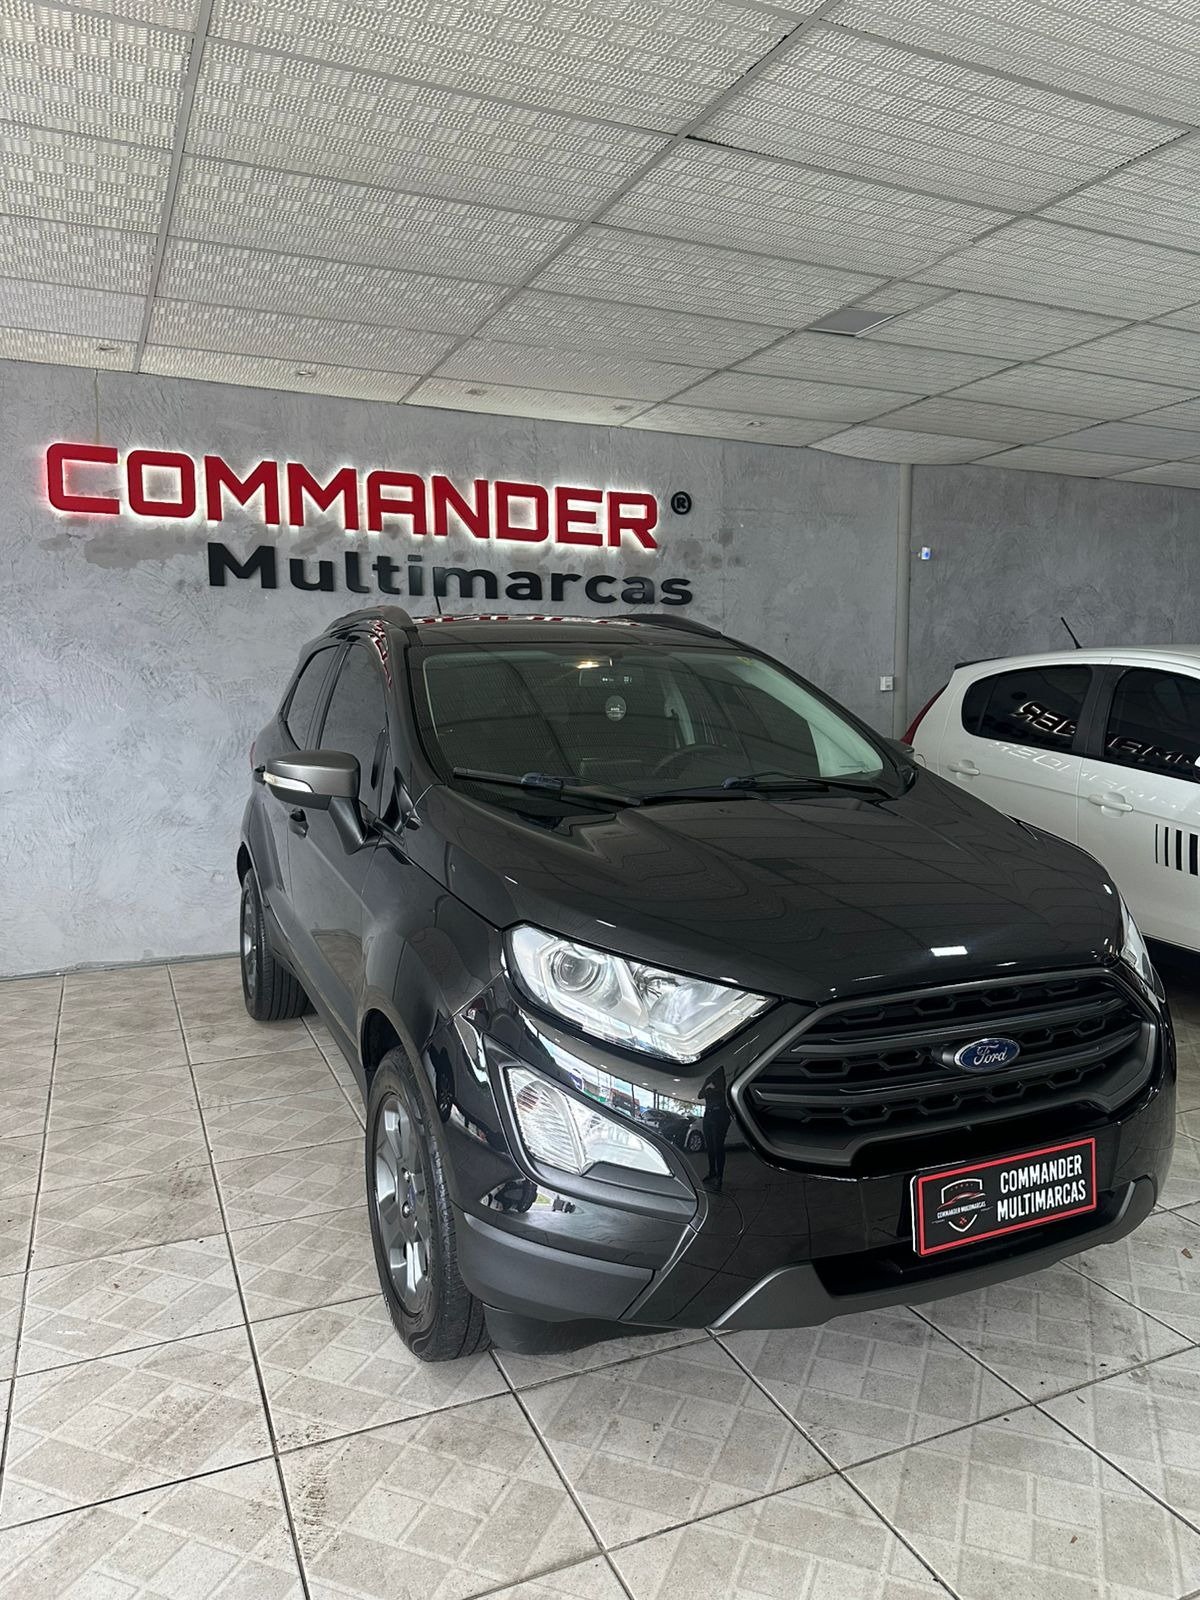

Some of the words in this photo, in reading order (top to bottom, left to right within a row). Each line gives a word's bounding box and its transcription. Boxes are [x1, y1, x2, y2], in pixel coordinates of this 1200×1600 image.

[46, 442, 658, 549] COMMANDER
[208, 542, 692, 605] Multimarcas
[974, 1044, 1008, 1065] Ford
[1000, 1154, 1082, 1193] COMMANDER
[996, 1180, 1086, 1222] MULTIMARCAS
